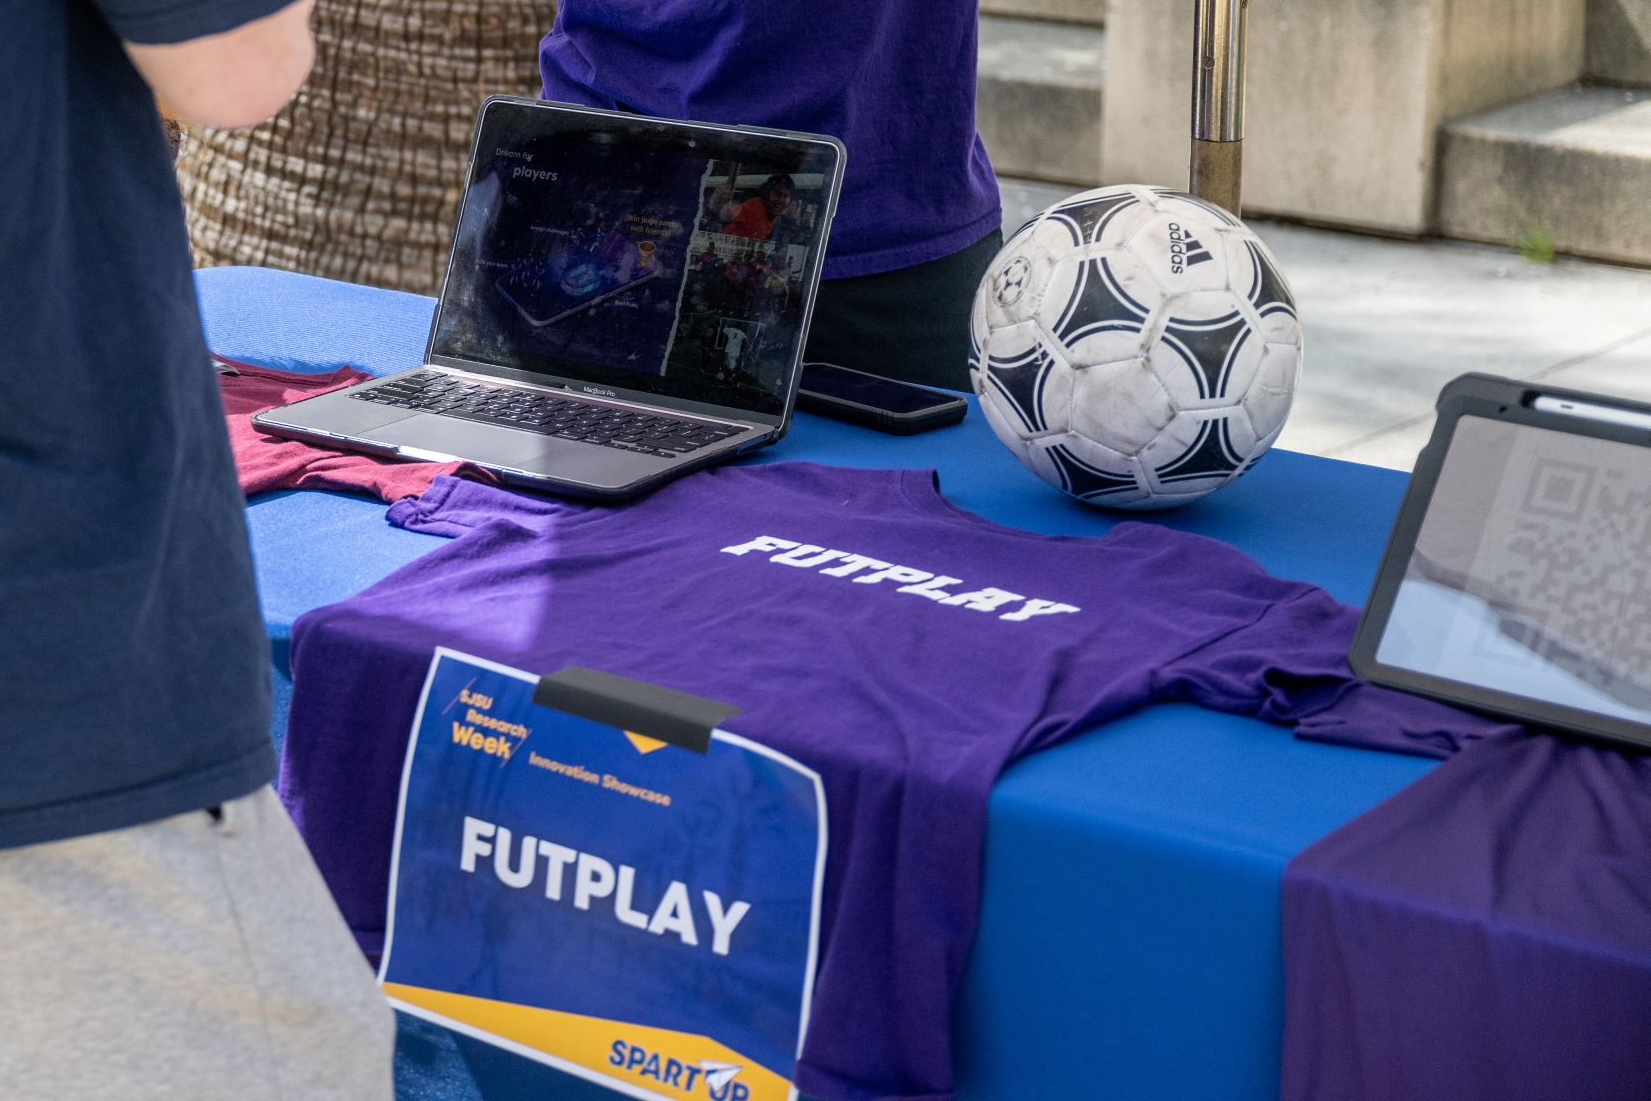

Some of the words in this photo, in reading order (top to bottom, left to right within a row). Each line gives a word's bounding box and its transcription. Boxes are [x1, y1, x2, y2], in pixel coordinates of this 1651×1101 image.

[495, 148, 521, 160] Dream
[522, 151, 535, 160] for
[512, 165, 558, 182] players
[1168, 222, 1184, 275] adidas
[583, 386, 607, 396] MacBook
[606, 390, 616, 398] Pro
[720, 535, 1081, 622] FUTPLAY
[459, 689, 494, 710] SJSU
[465, 708, 528, 739] Research
[452, 721, 513, 760] Week
[528, 751, 600, 785] Innovation
[602, 774, 671, 807] Showcase
[459, 815, 752, 957] FUTPLAY
